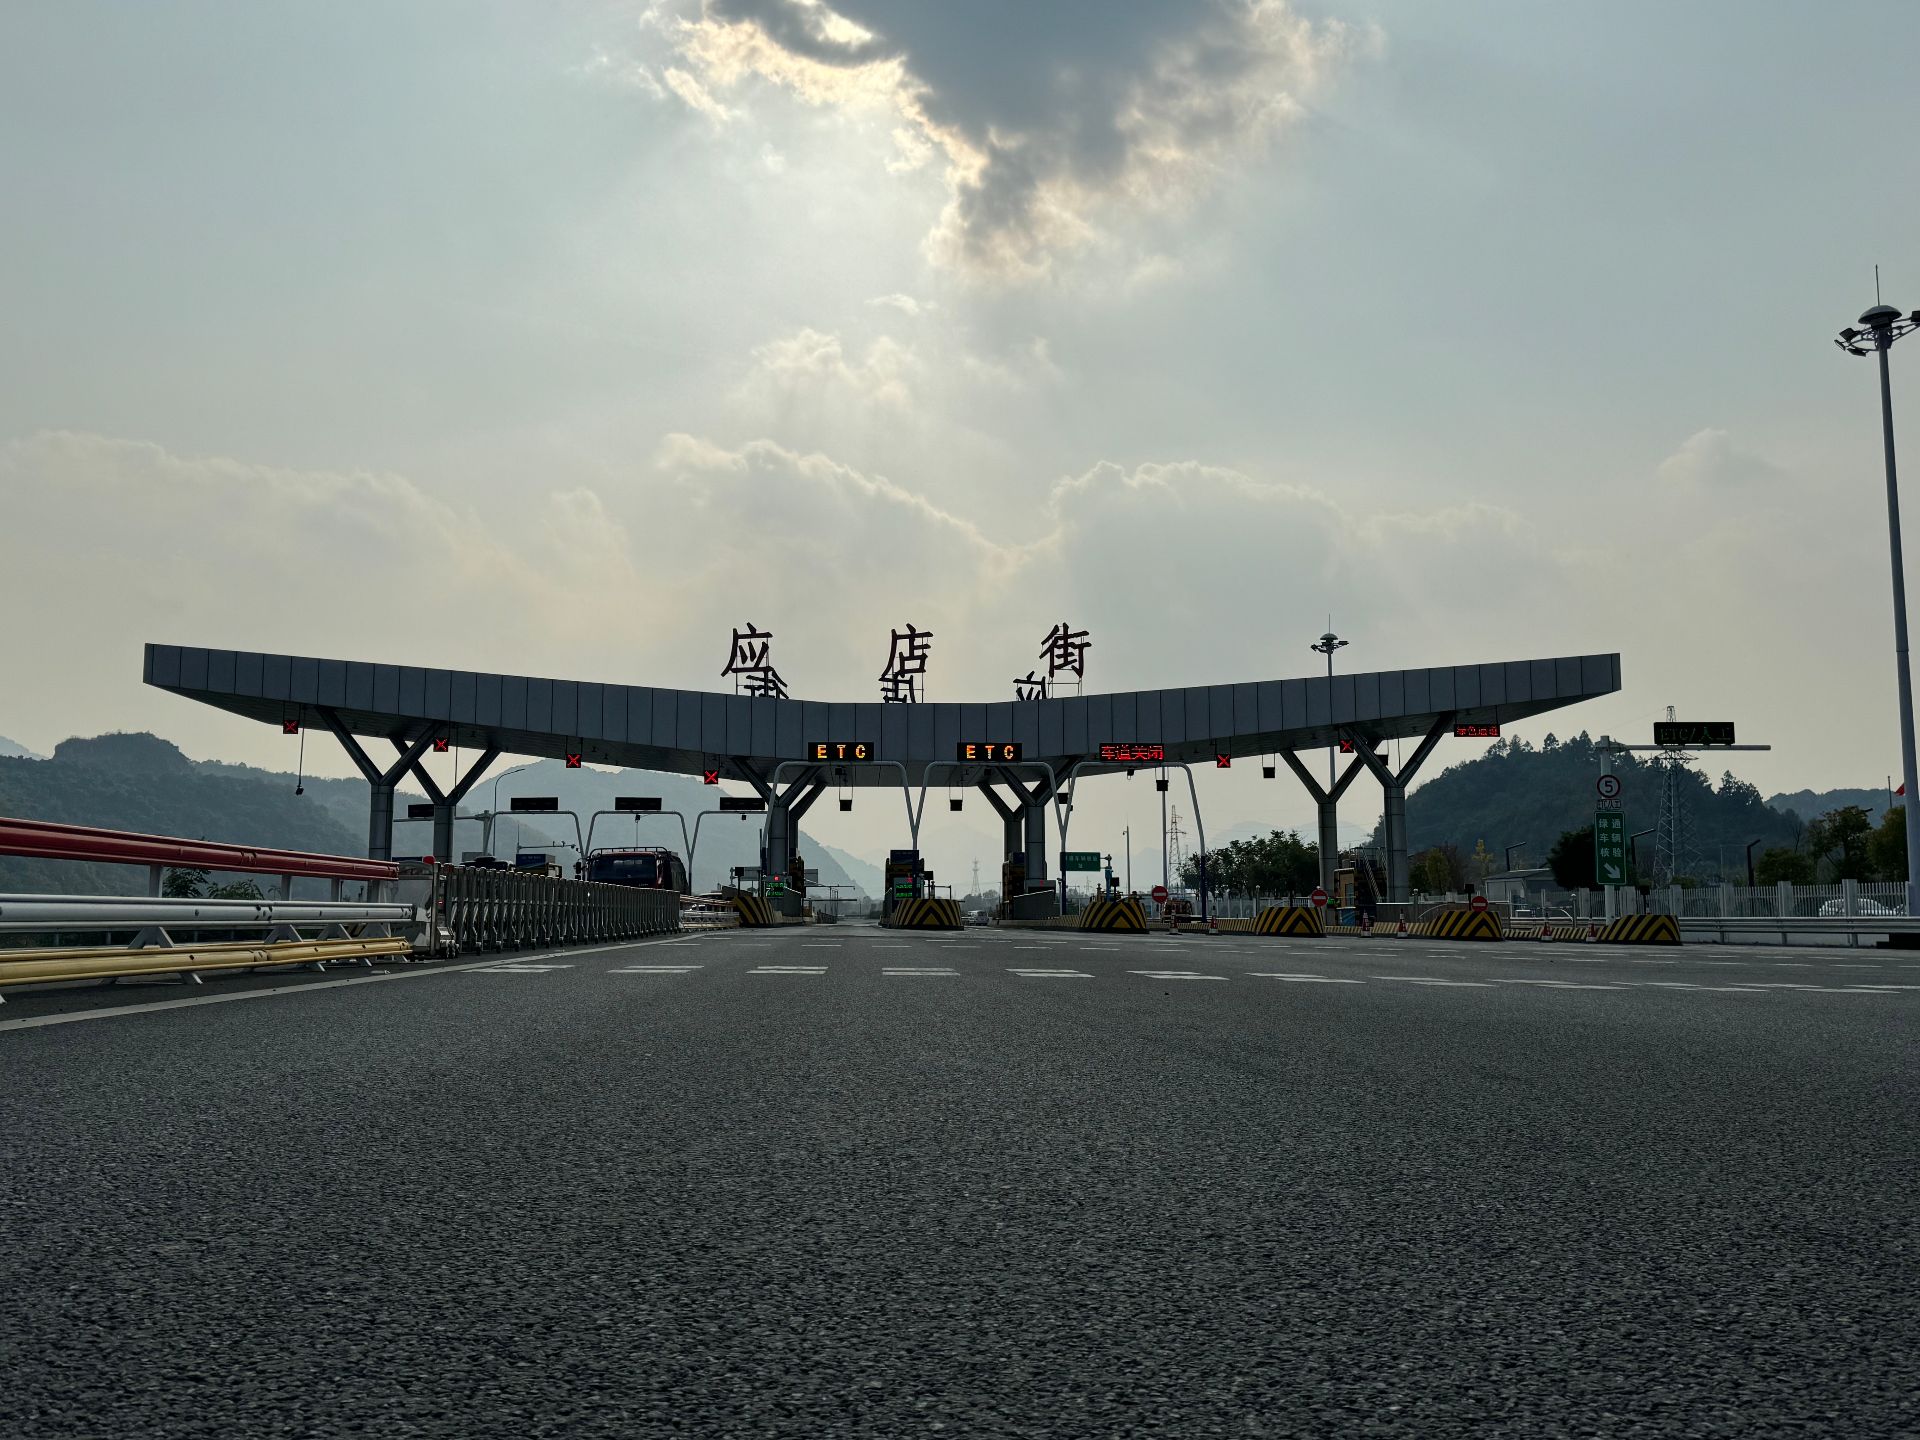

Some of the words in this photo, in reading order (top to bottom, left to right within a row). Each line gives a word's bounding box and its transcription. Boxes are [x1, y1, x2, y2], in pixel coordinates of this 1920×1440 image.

[721, 622, 1092, 680] 应店街
[817, 745, 867, 759] ETC
[966, 745, 1014, 759] ETC
[1101, 745, 1164, 760] 车道关闭
[1605, 781, 1613, 793] 5
